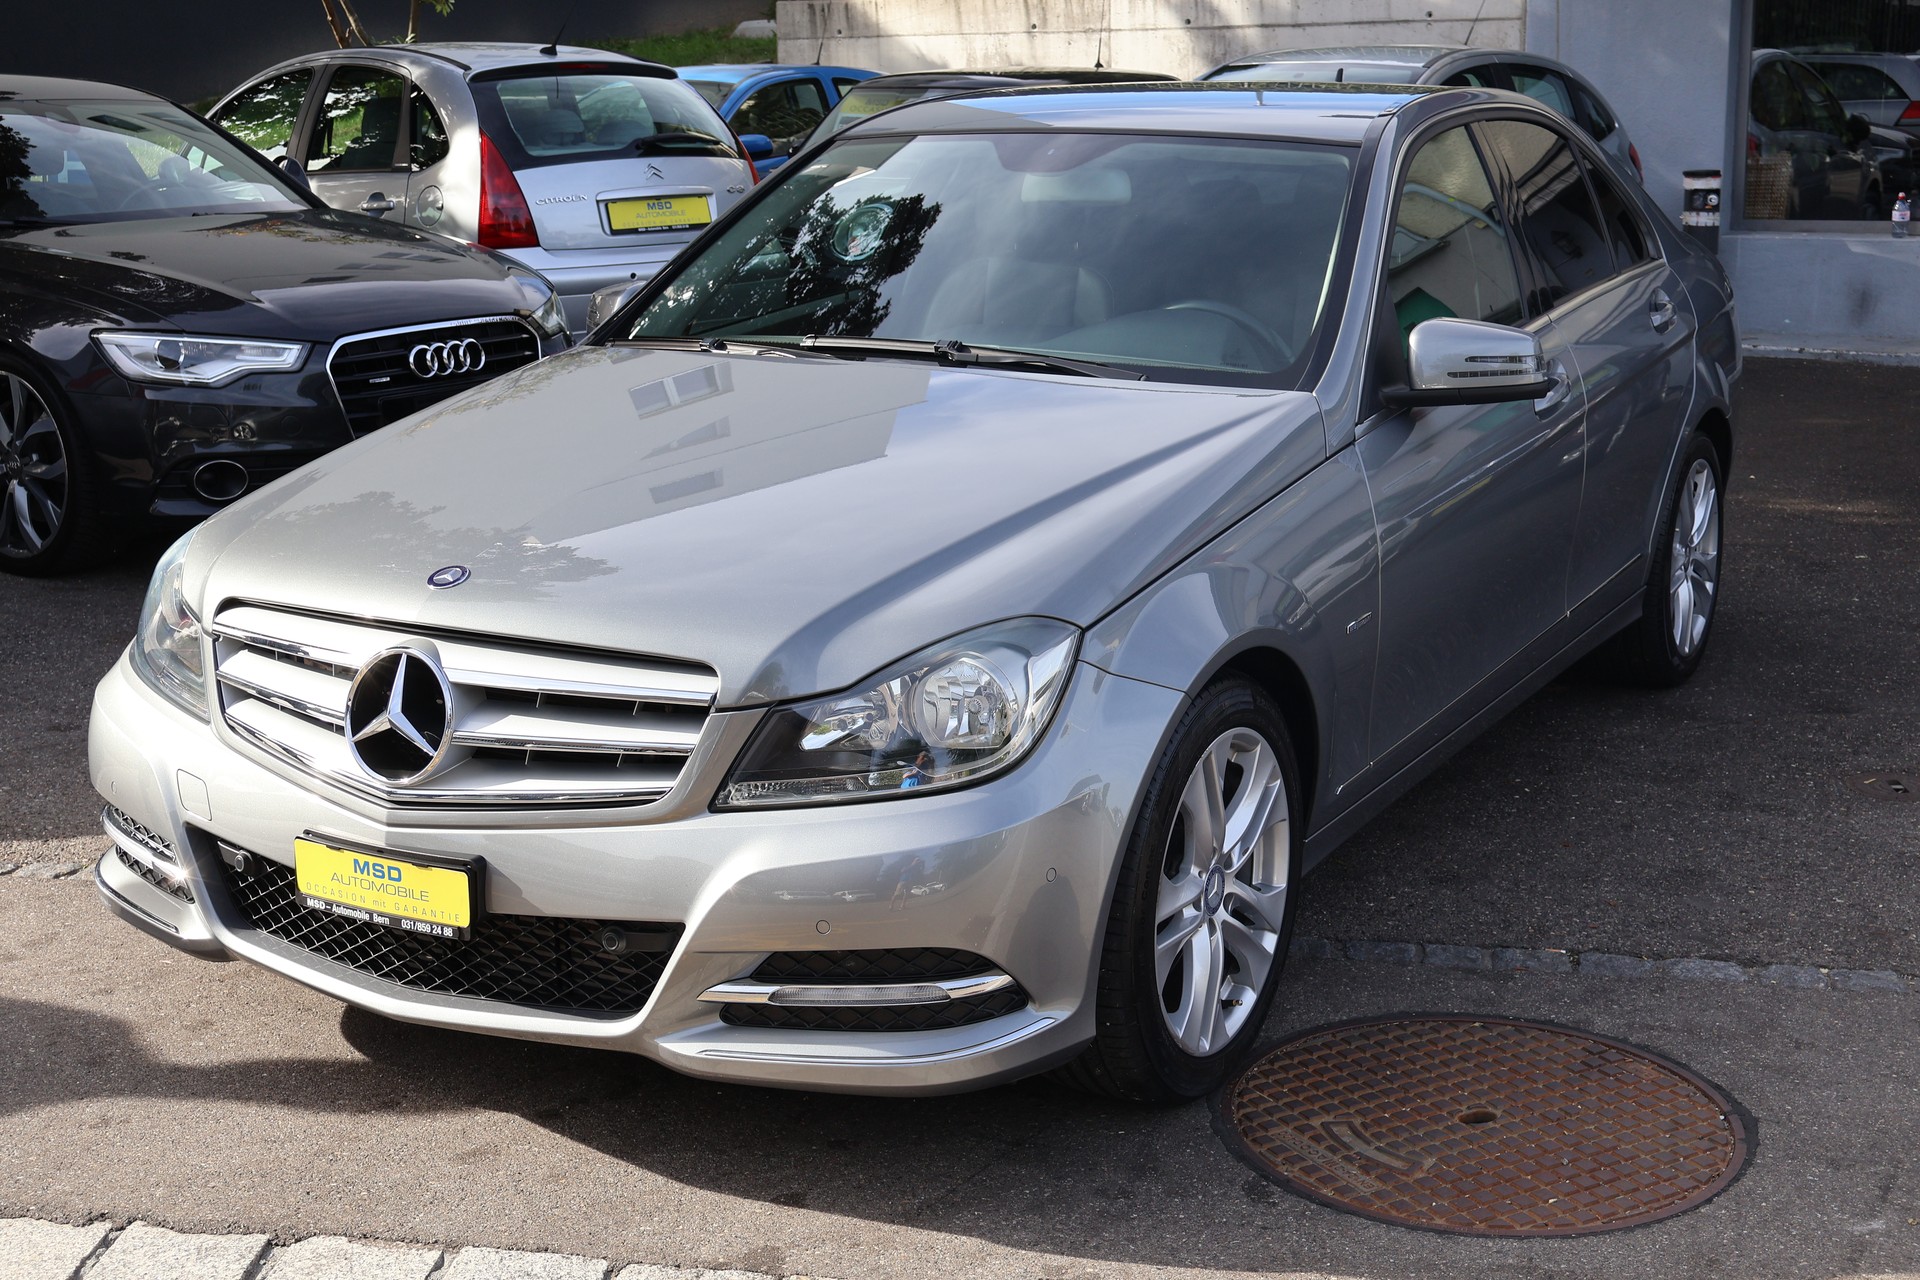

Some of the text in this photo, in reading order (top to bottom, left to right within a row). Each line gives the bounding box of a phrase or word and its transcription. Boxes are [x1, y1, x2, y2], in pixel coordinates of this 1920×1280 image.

[635, 209, 687, 219] AUTOMOBILE
[646, 201, 673, 211] MSD
[353, 858, 402, 883] MSD
[331, 872, 430, 903] AUTOMOBILE
[306, 881, 460, 923] OCCASION mit GARANTIE
[372, 913, 390, 926] Bern
[401, 919, 431, 933] 031/859
[432, 925, 442, 935] 24
[443, 927, 453, 937] 88
